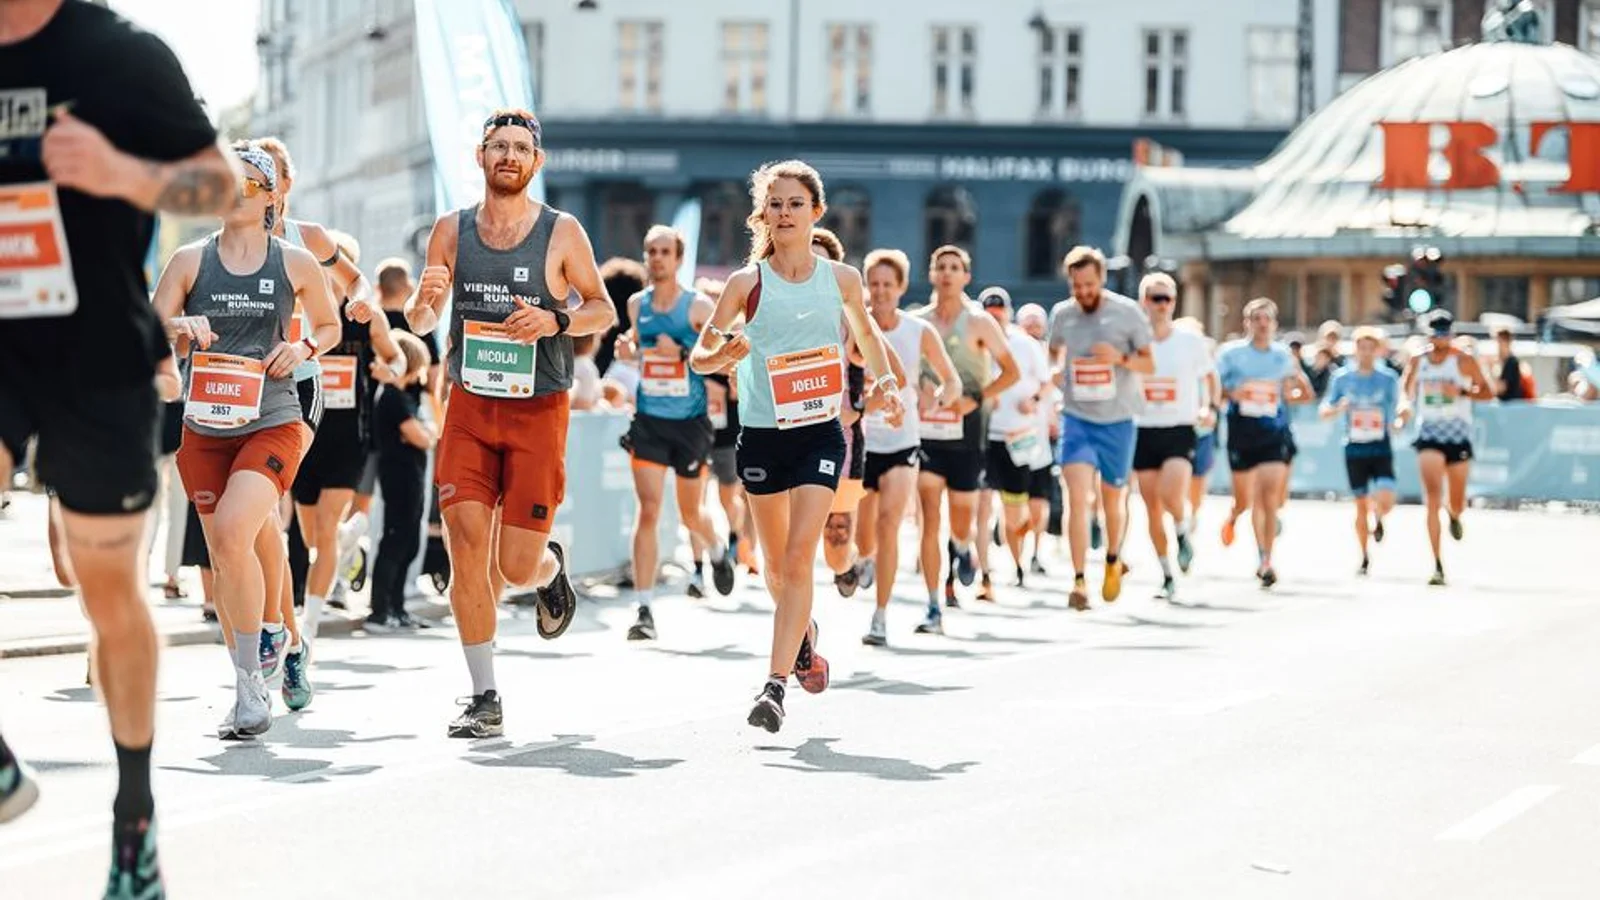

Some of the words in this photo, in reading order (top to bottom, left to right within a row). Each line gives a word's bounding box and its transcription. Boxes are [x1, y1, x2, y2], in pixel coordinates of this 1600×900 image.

[940, 156, 1054, 181] HALIFAX
[1058, 157, 1134, 182] BURG
[462, 282, 510, 294] VIENNA
[210, 293, 250, 302] VIENNA
[483, 293, 541, 305] RUNNNG
[228, 300, 275, 310] RUNNING
[477, 348, 518, 365] NICOLAJ
[488, 372, 504, 382] 900
[205, 381, 241, 397] ULRIKE
[791, 375, 828, 393] JOELLE
[211, 404, 231, 415] 2857
[803, 399, 824, 411] 3858
